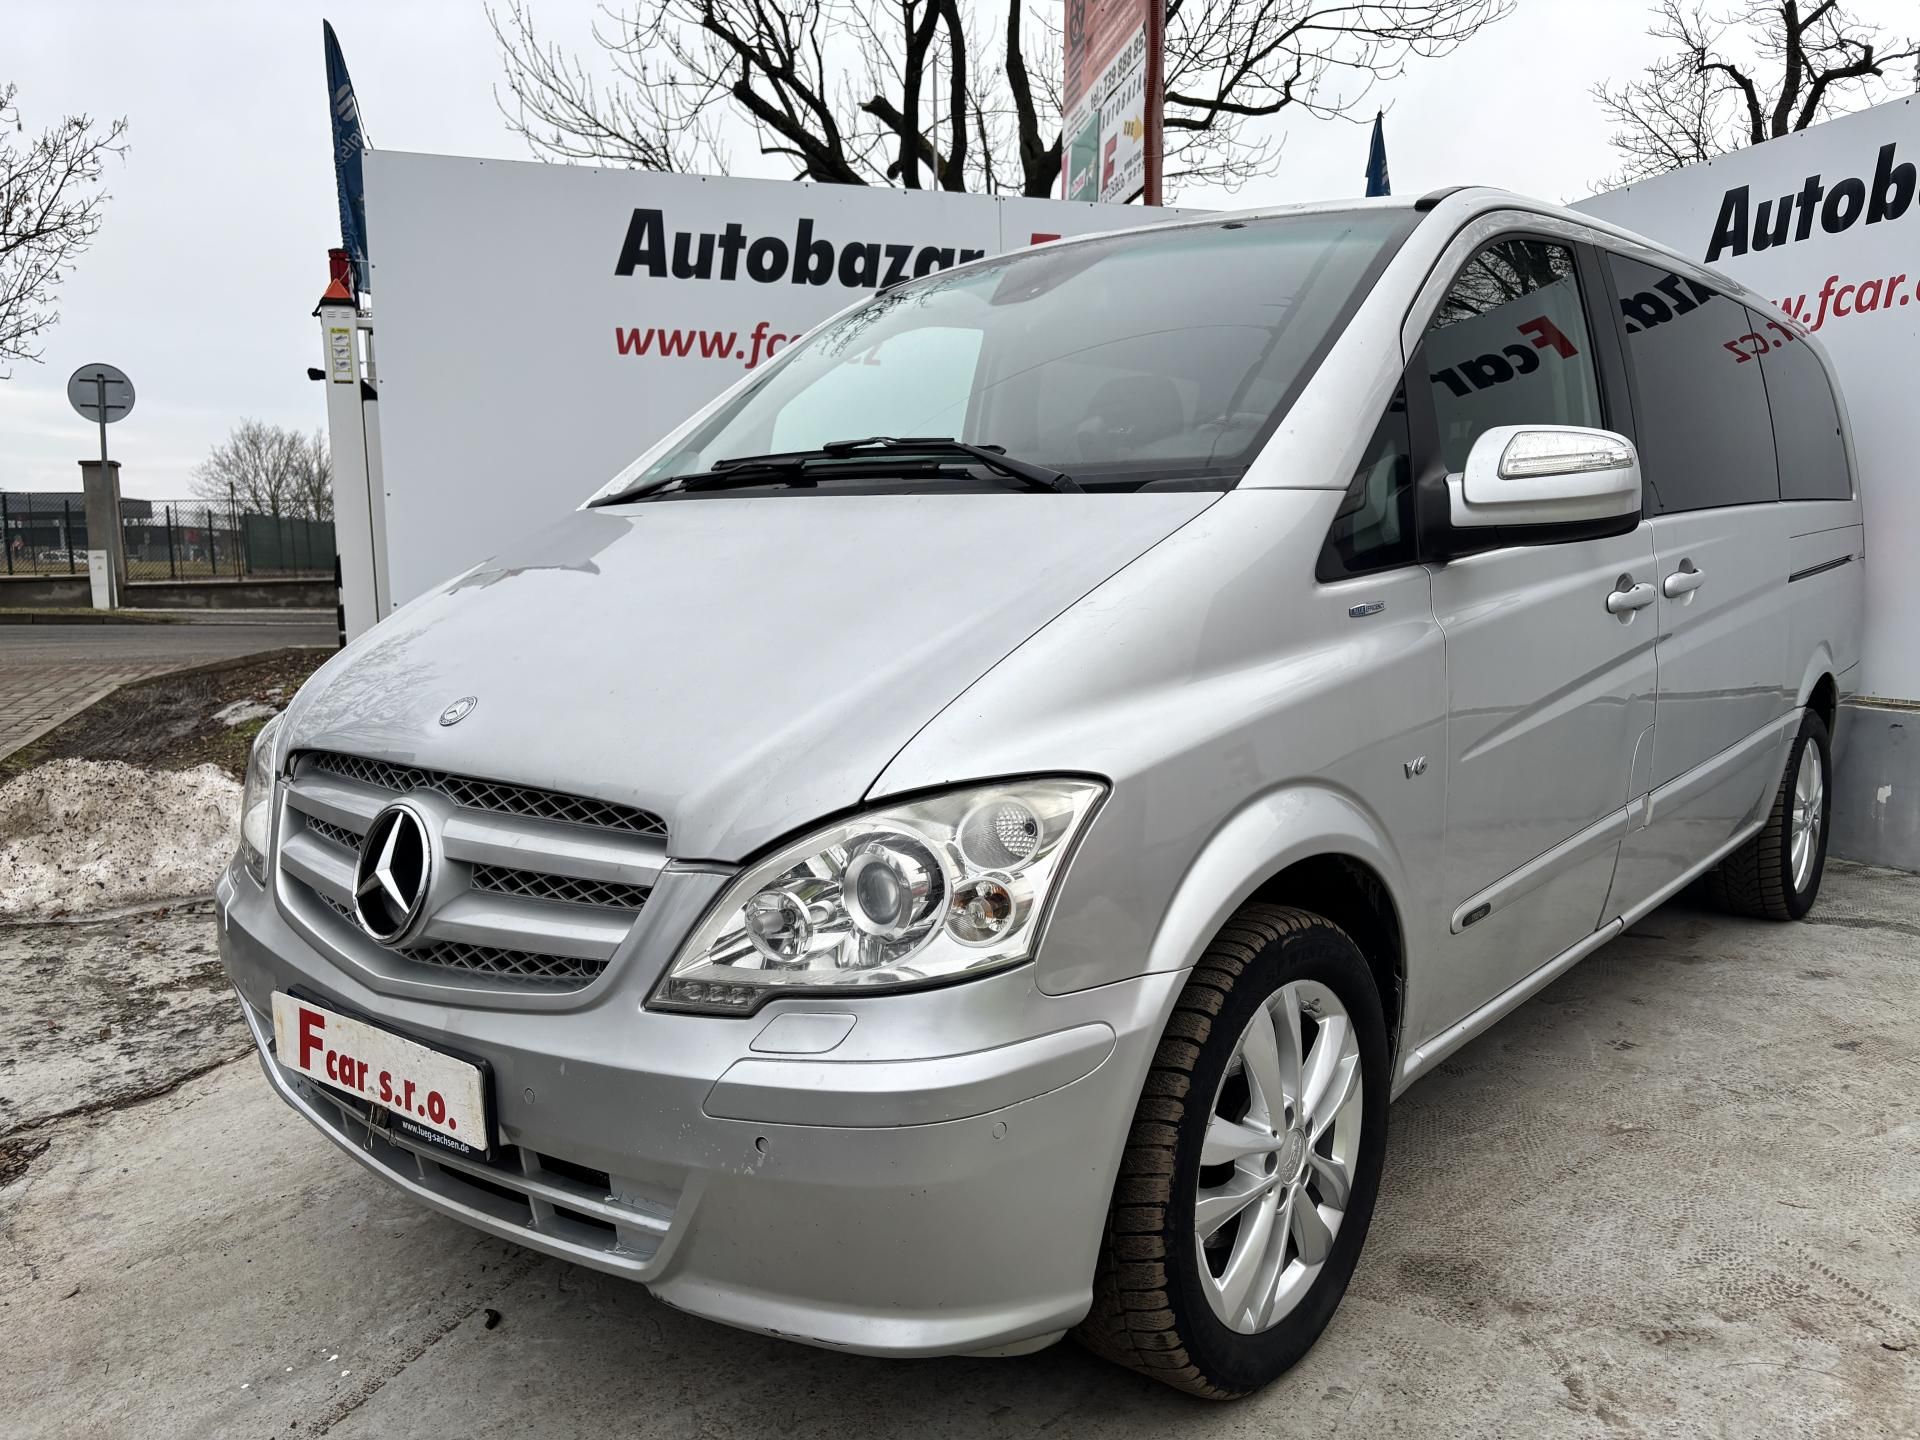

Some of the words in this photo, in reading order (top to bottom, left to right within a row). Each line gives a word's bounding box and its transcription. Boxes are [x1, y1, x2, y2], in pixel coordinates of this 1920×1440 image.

[1133, 32, 1146, 60] 85
[1101, 70, 1144, 130] AUTOBAZA
[1704, 142, 1920, 264] Autob
[379, 1070, 457, 1131] s.r.o.
[402, 1120, 470, 1154] www.lueg-sachsen.de
